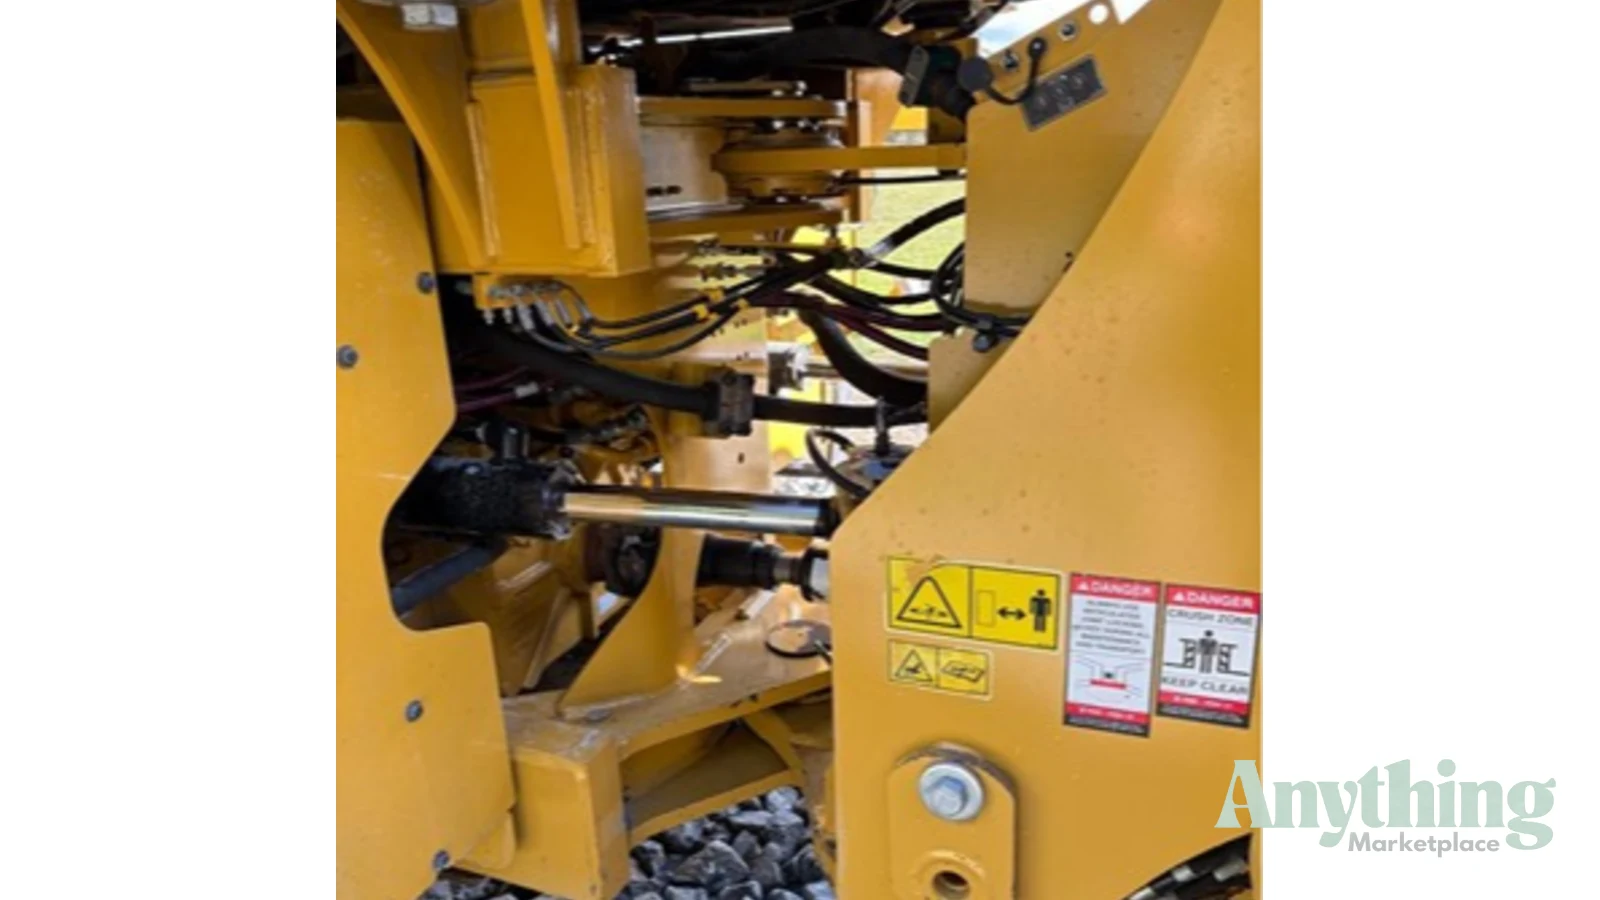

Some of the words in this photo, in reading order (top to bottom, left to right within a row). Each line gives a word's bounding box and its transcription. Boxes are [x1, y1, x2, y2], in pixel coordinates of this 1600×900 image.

[1090, 581, 1152, 598] DANGER
[1186, 589, 1254, 609] DANGER
[1167, 608, 1215, 621] CRUSH
[1217, 613, 1253, 626] ZONE
[1161, 677, 1197, 688] KEEP
[1200, 681, 1248, 695] CLEAR
